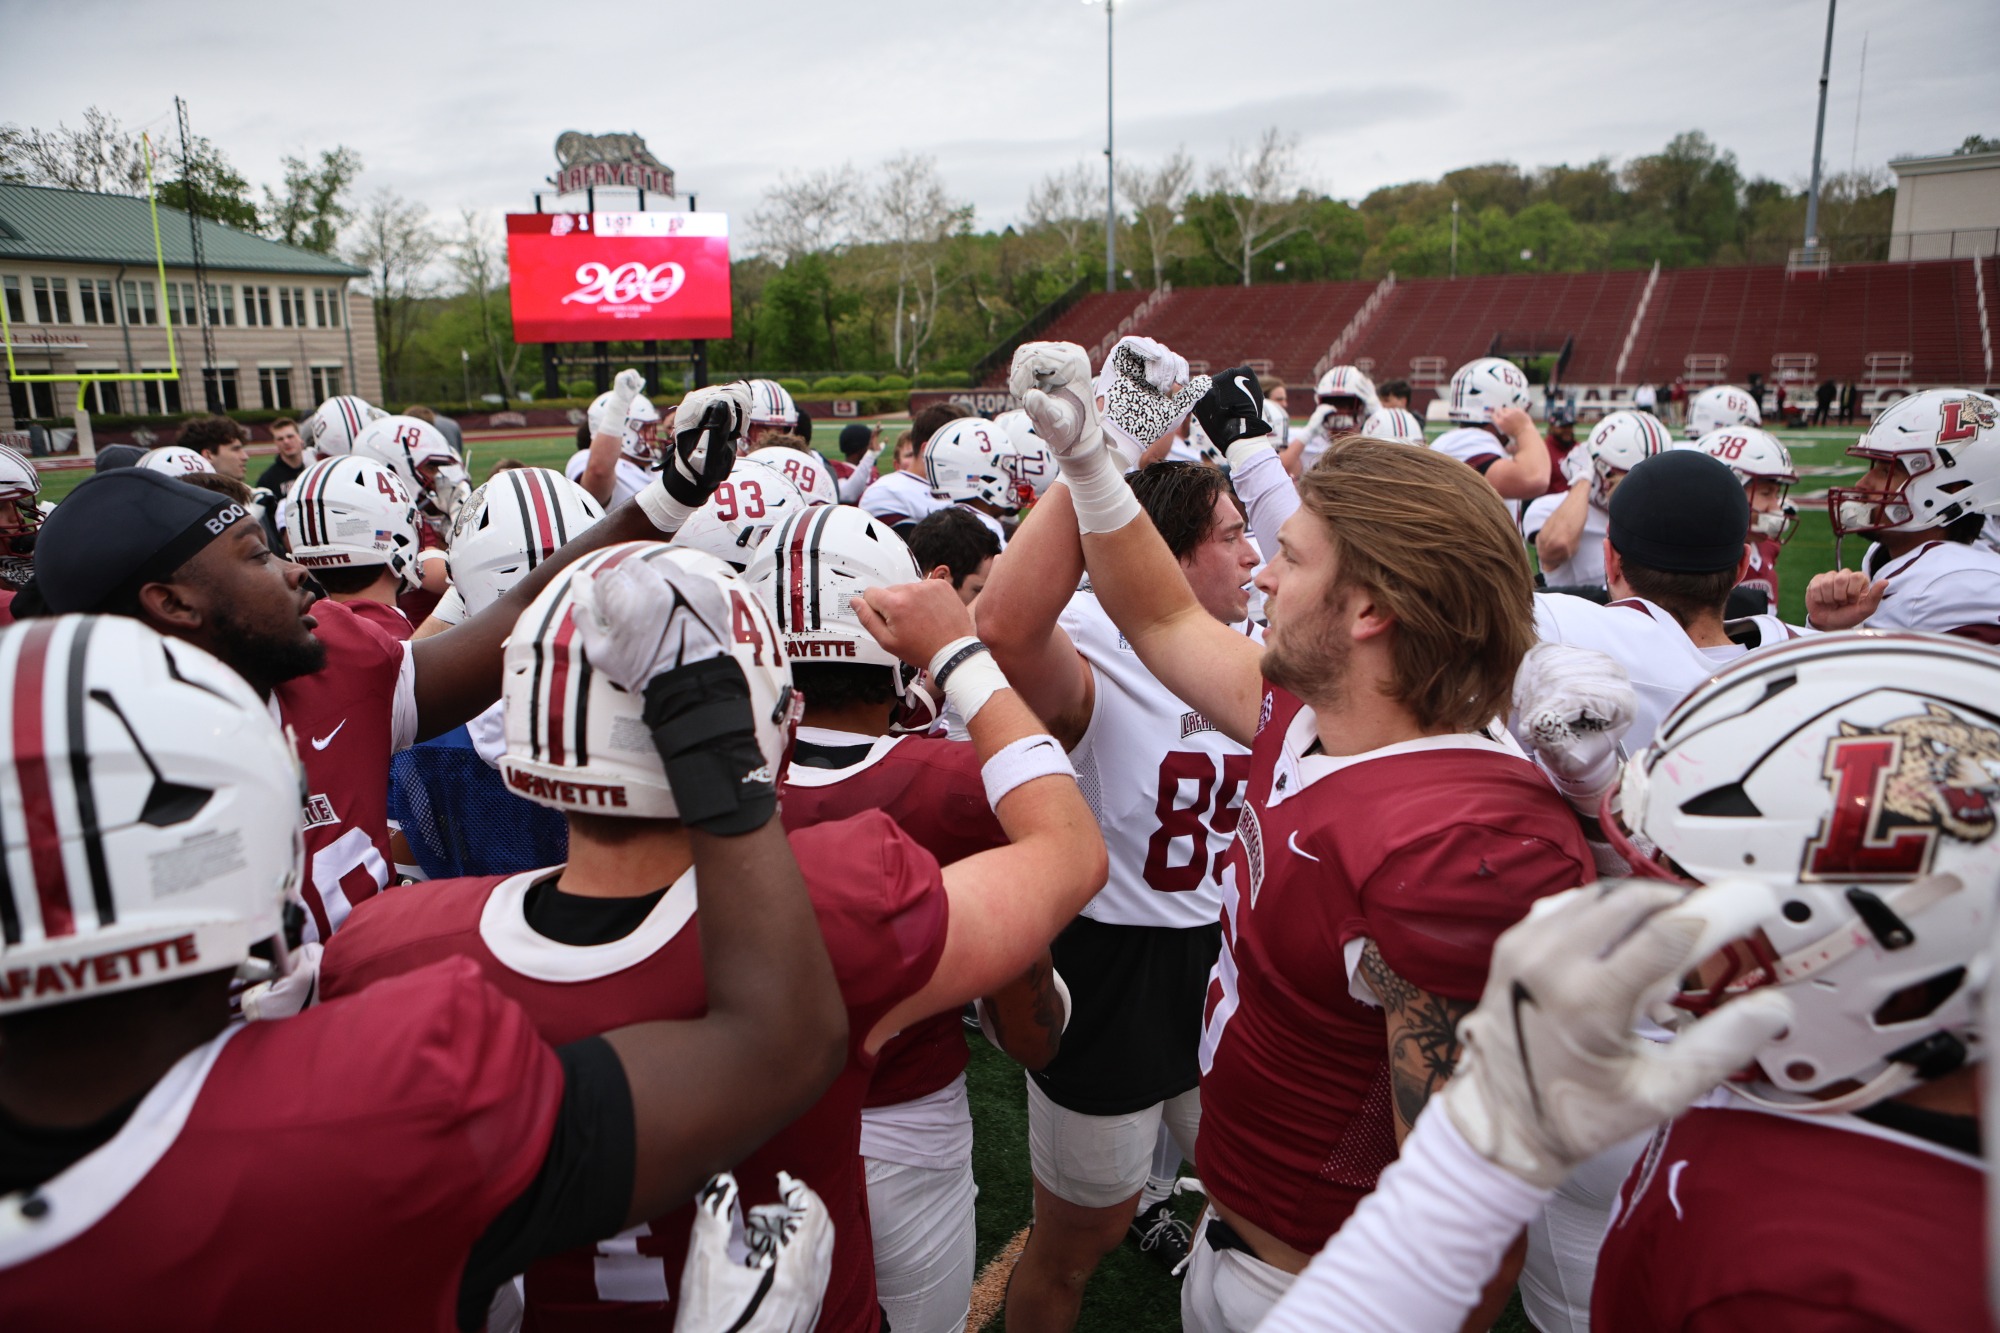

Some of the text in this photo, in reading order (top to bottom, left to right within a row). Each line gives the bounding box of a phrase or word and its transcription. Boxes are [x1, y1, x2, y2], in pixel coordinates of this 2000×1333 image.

[557, 163, 675, 197] LAFAYETTE
[560, 261, 686, 304] 200
[393, 424, 421, 448] 18
[975, 431, 992, 453] 3
[1710, 435, 1748, 460] 38
[178, 455, 205, 472] 55
[783, 458, 816, 493] 89
[376, 471, 410, 503] 43
[714, 480, 765, 522] 93
[937, 669, 950, 684] OVE
[506, 766, 628, 807] LAFAYETTE
